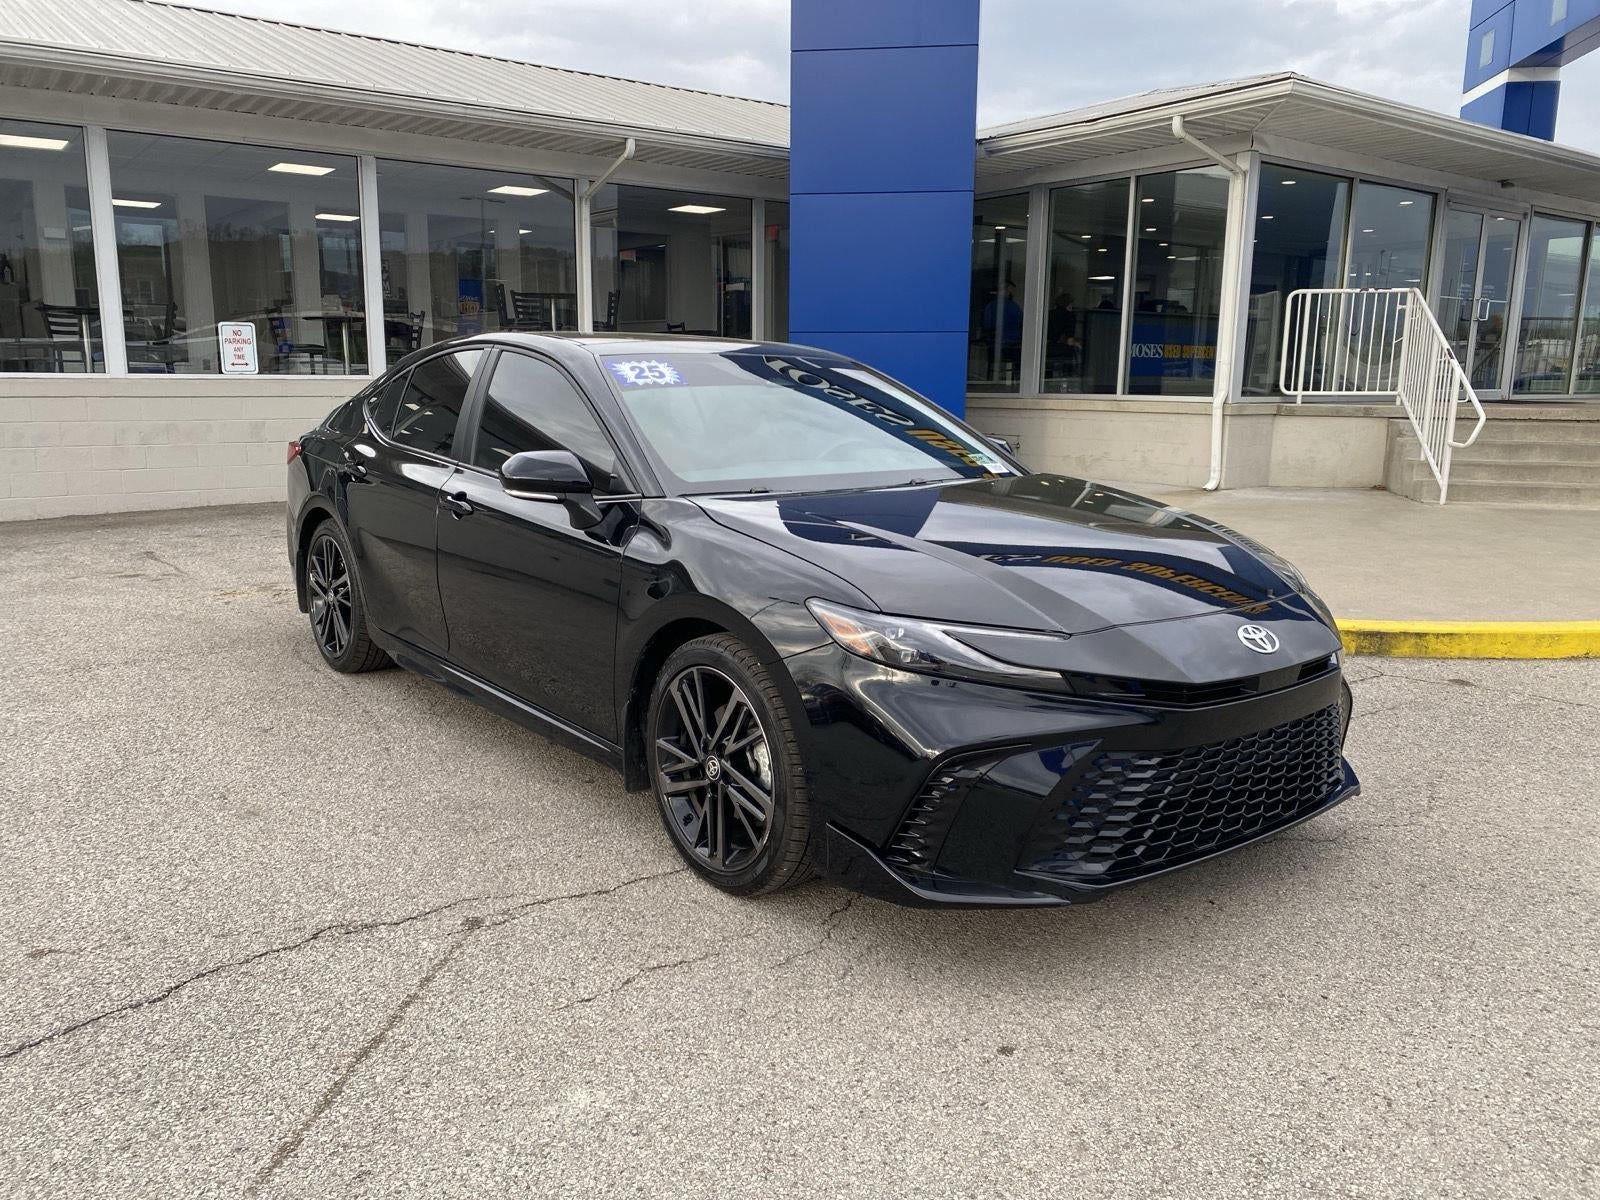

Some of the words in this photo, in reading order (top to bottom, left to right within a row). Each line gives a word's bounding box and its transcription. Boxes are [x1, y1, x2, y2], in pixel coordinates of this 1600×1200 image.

[232, 329, 242, 337] NO
[224, 337, 252, 345] PARKING
[629, 365, 666, 380] 25
